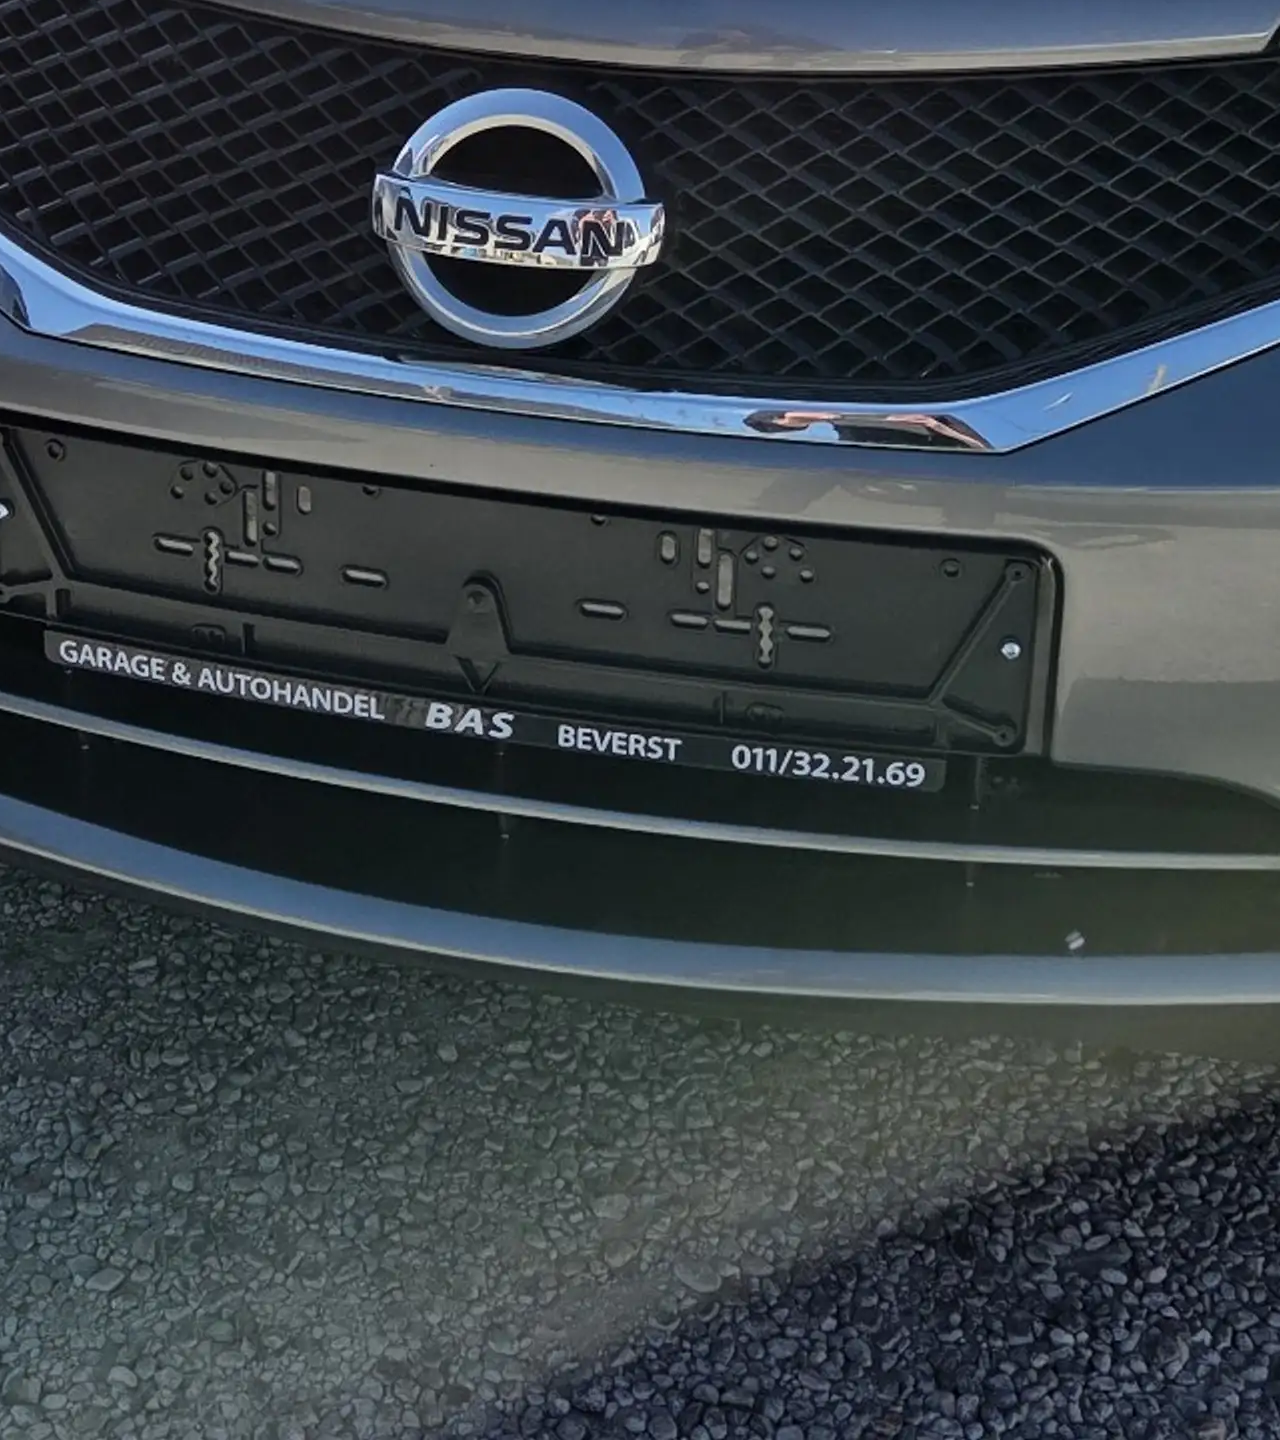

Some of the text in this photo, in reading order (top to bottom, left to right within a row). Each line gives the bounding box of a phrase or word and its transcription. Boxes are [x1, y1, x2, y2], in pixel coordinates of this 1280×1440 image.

[394, 196, 625, 258] NISSAN
[59, 639, 926, 788] GARAGE & AUTOHANDEL BAS BEVERST 011/32.21.69
